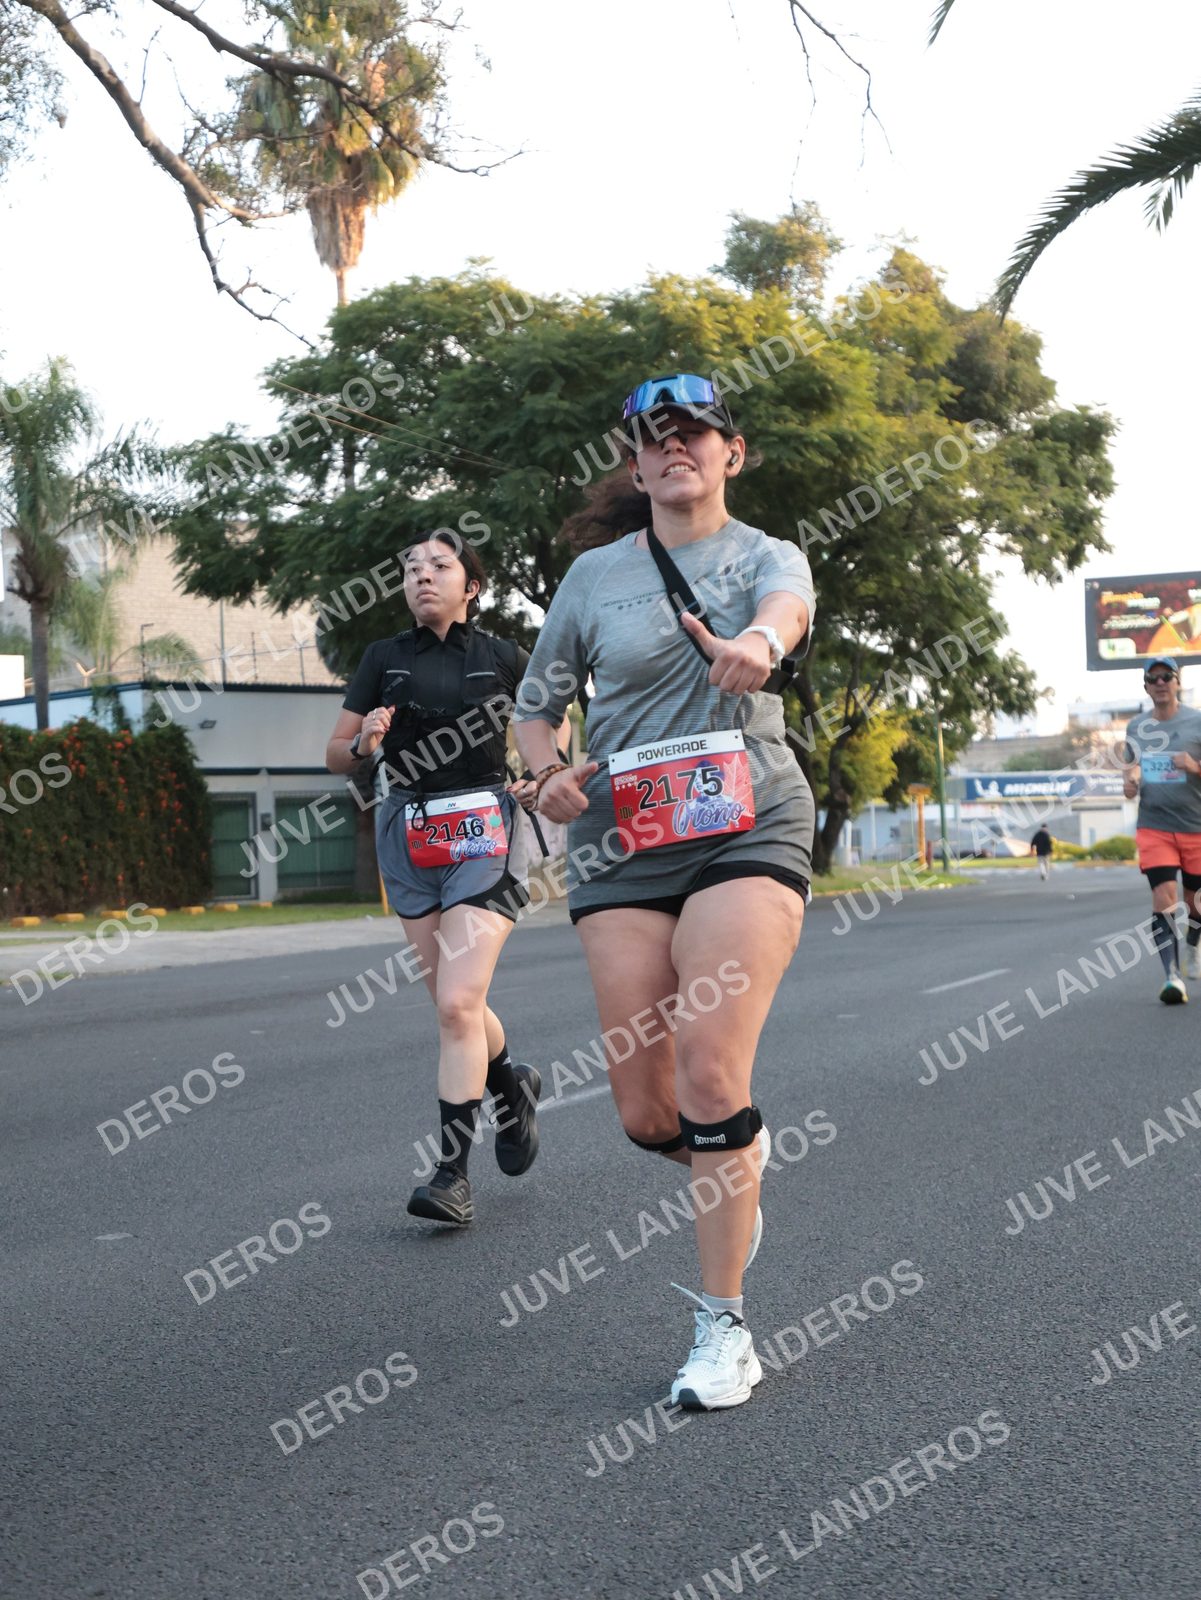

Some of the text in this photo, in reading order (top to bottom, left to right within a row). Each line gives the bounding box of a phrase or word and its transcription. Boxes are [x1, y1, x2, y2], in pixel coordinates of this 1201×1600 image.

[637, 739, 708, 762] POWERADE
[636, 765, 723, 811] 2175
[425, 817, 485, 845] 2146
[694, 1133, 727, 1145] GOUNOD
